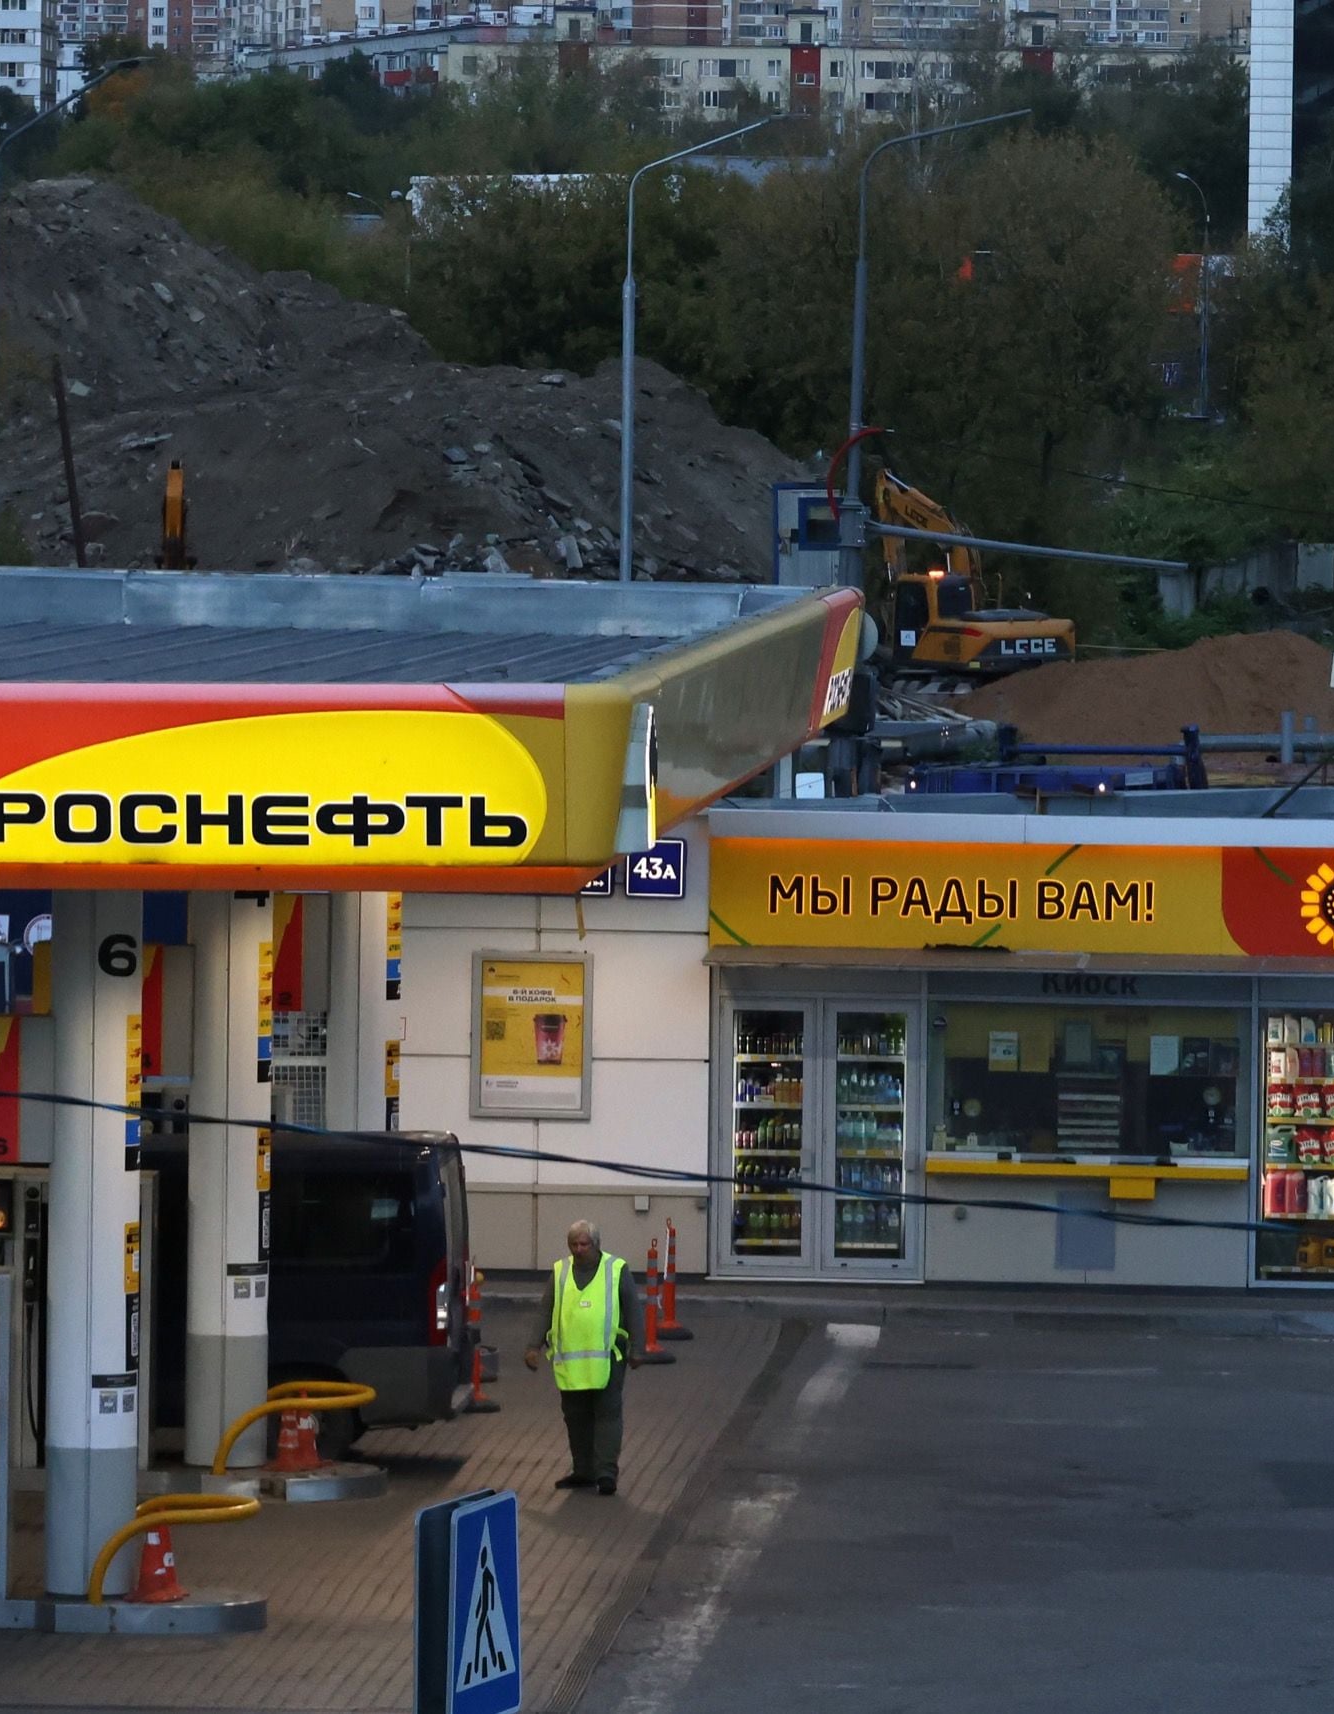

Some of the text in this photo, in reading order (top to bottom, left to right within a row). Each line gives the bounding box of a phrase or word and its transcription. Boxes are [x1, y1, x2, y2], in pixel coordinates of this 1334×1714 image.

[768, 874, 1155, 924] МЫ РАДЫ ВАМ!
[98, 934, 137, 977] 6
